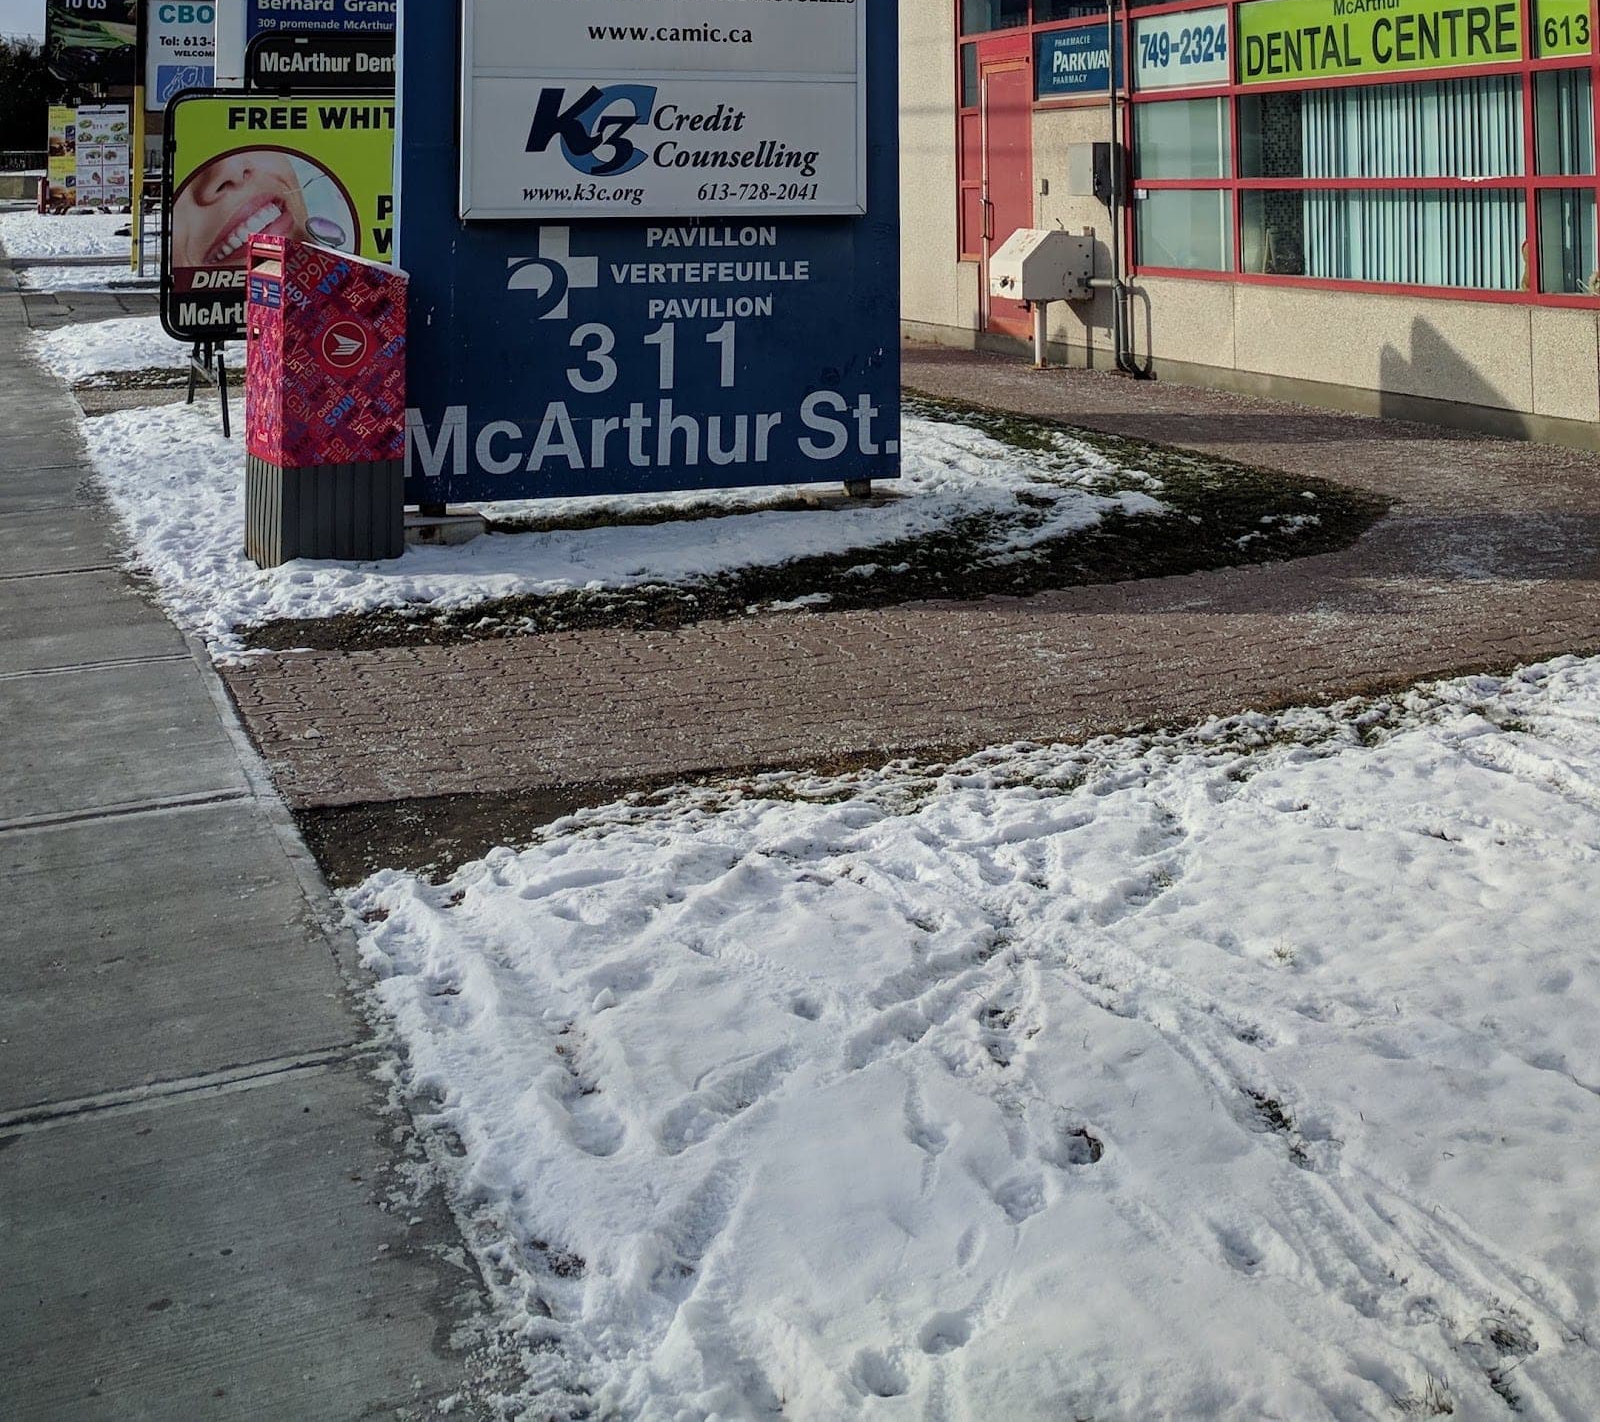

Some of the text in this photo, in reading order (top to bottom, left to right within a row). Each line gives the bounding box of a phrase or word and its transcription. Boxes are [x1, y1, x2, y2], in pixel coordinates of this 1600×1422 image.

[158, 5, 214, 24] CBO
[258, 18, 393, 30] 309 promenade McArthur
[160, 35, 180, 47] Tel:
[588, 23, 753, 43] www.camic.ca
[1054, 35, 1090, 47] PHARMACIE
[1246, 2, 1517, 77] DENTAL CENTRE
[1544, 14, 1590, 48] 613
[1140, 24, 1226, 69] 749-2324
[260, 52, 350, 72] McArthur
[1052, 74, 1087, 85] PHARMACY
[228, 106, 308, 130] FREE
[653, 104, 745, 133] Credit
[653, 140, 819, 177] Counselling
[522, 183, 818, 205] www.k3c.org 613-728-2041
[646, 226, 776, 248] PAVILLON
[610, 260, 810, 284] VERTEFEUILLE
[648, 295, 772, 319] PAVILION
[404, 391, 898, 477] McArthur St.
